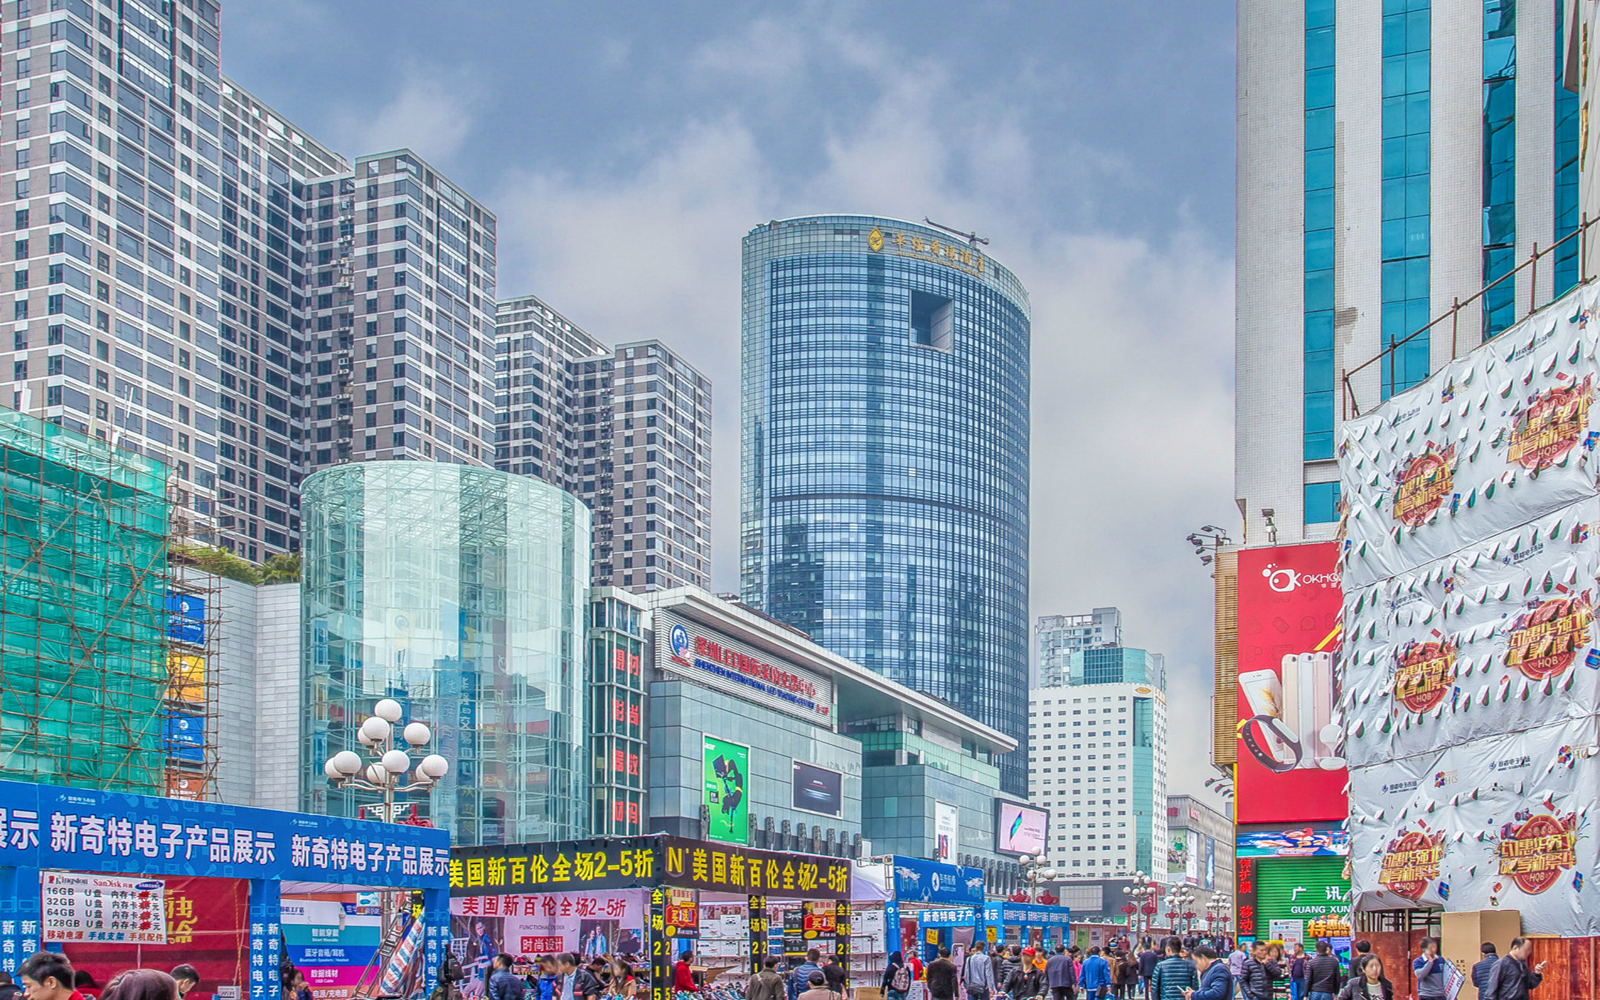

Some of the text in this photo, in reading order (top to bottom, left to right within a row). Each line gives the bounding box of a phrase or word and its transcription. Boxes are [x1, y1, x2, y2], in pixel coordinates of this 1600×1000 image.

[1537, 444, 1559, 458] HQB
[1537, 655, 1559, 668] HQB
[51, 811, 276, 865] 新奇特电子产品展示
[291, 833, 450, 877] 新奇特电子产品展示
[449, 848, 654, 888] 美国新百伦全场2-5折
[692, 848, 848, 893] 美国新百伦全场2-5折
[93, 879, 121, 888] SanDisk
[1529, 872, 1545, 882] HQB
[46, 887, 159, 901] 16GB U盘 内存卡 元
[1239, 859, 1253, 935] 保护膜 移动
[46, 897, 160, 911] 32GB U盘 内存卡 元
[463, 894, 627, 918] 美国新百伦全场2-5折
[1291, 905, 1350, 914] GUANG XUN
[46, 908, 161, 921] 64GB U盘 内存卡 元
[923, 909, 998, 923] 新奇特电子产展示
[47, 919, 161, 931] 128GB U盘 内存卡 元
[47, 930, 164, 942] 移动电源 手机支架 手机配件
[521, 938, 564, 952] 时尚设计
[252, 923, 263, 997] 新奇特电子
[268, 923, 279, 997] 新奇特电子
[310, 969, 338, 978] 数据线材
